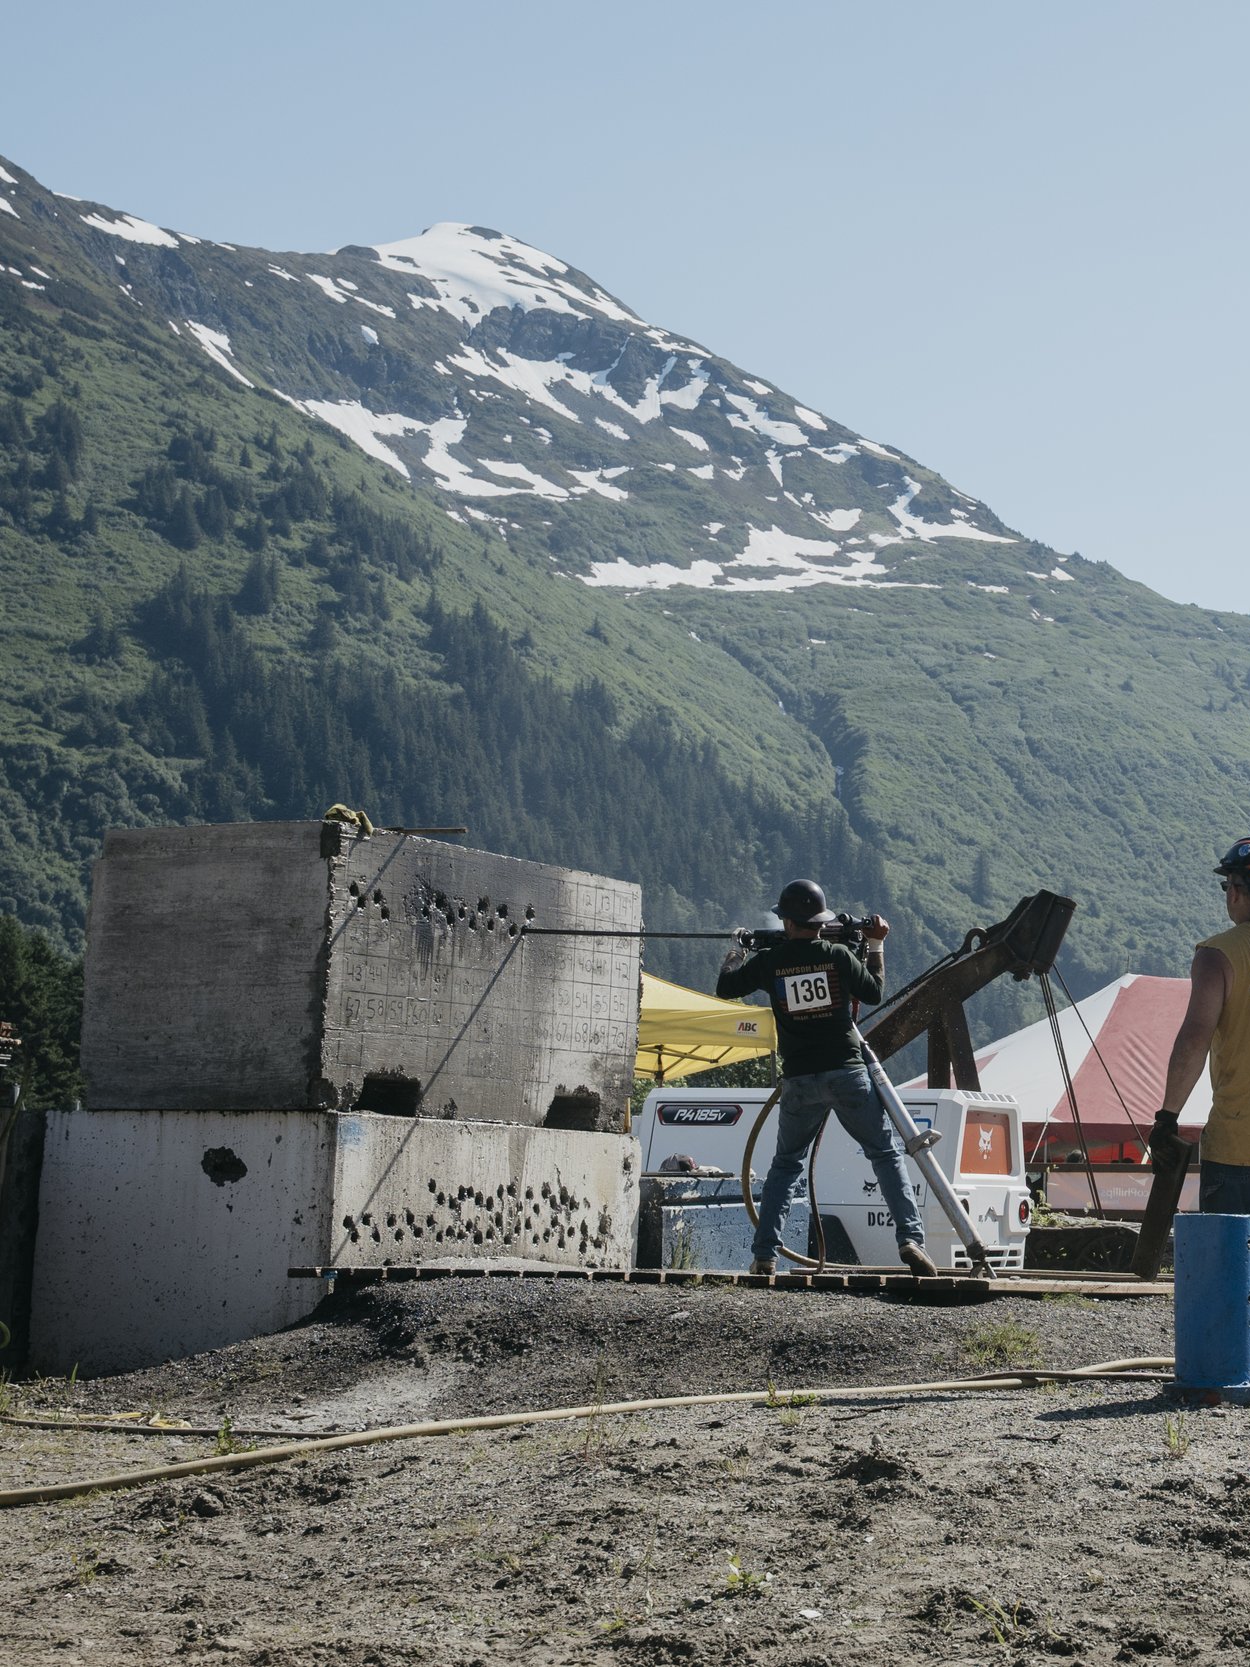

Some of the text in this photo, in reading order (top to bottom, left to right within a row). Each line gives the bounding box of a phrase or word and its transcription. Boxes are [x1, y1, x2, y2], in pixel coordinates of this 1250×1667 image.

[582, 893, 592, 907] 12
[601, 894, 611, 912] 13
[579, 956, 593, 973] 40
[615, 961, 630, 980] 42
[775, 962, 835, 976] DAWSON MINE
[346, 960, 362, 982] 43
[575, 991, 588, 1009] 54
[613, 994, 625, 1014] 56
[791, 977, 827, 1004] 136
[367, 999, 384, 1020] 58
[390, 1000, 404, 1020] 59
[556, 1021, 568, 1042] 67
[574, 1022, 589, 1043] 68
[612, 1026, 625, 1049] 70
[737, 1022, 758, 1032] ABC
